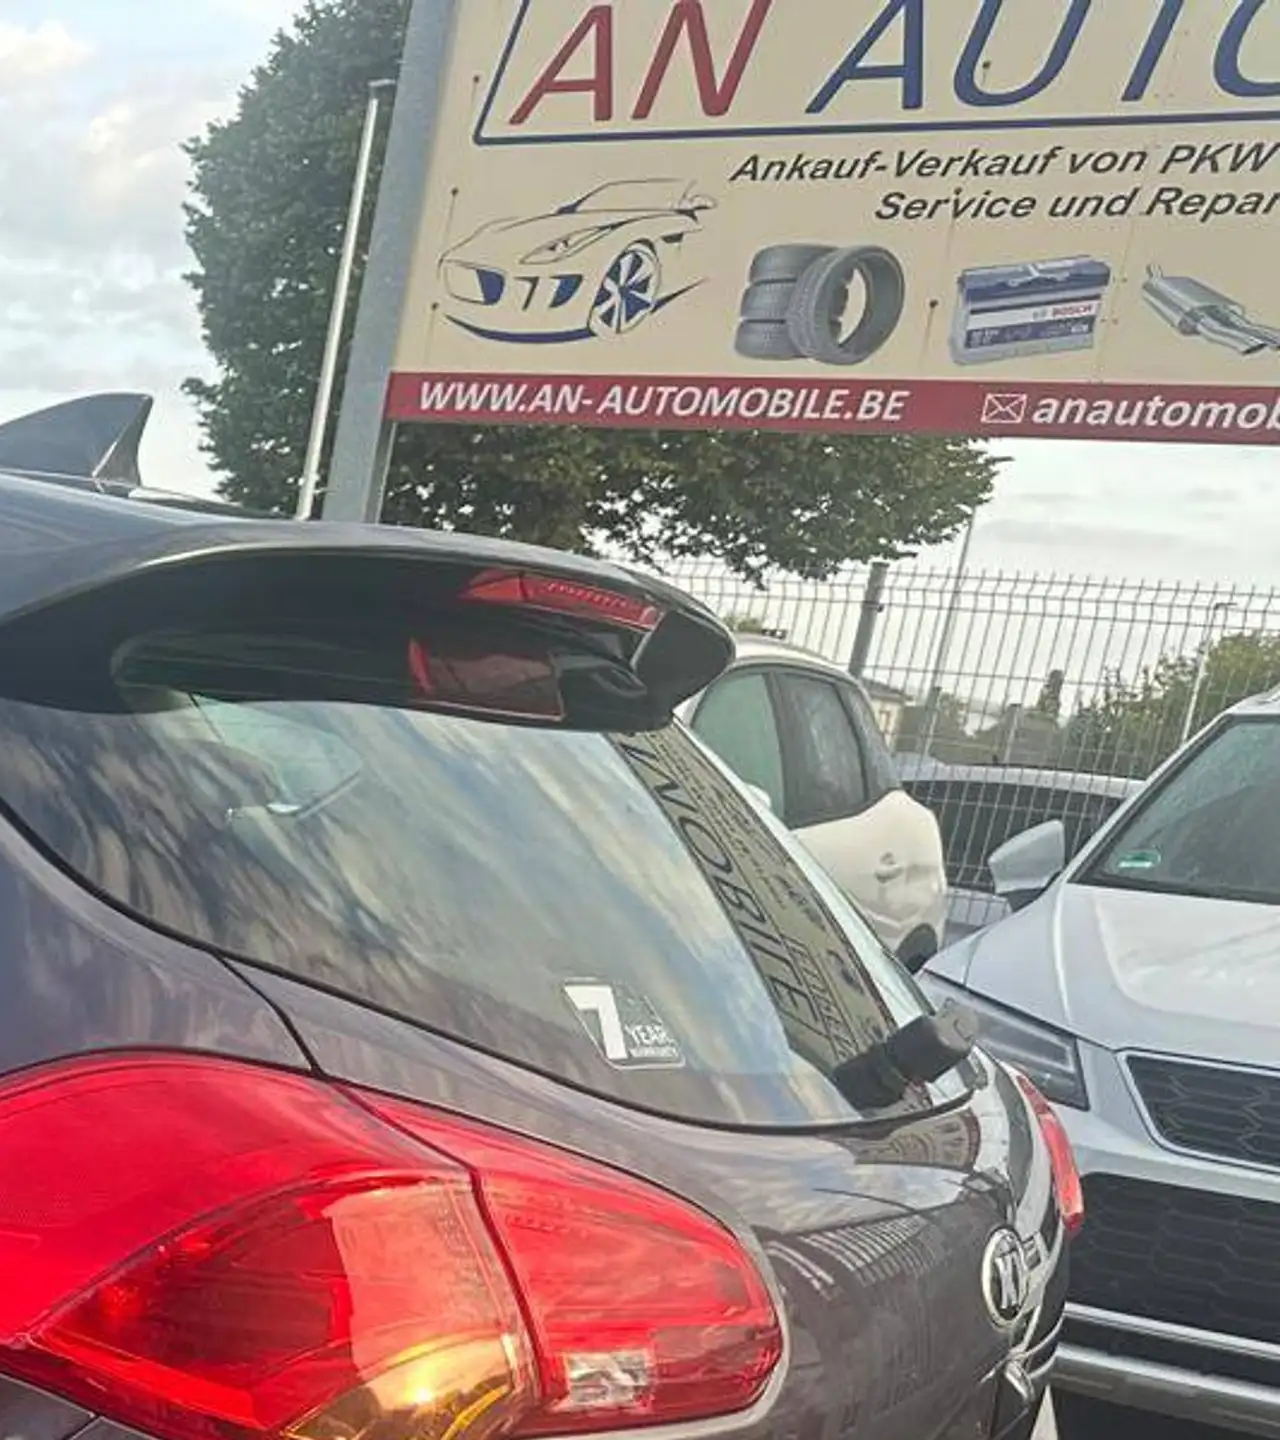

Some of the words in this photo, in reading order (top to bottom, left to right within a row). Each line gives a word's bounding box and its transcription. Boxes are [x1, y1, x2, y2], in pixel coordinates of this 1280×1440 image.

[508, 0, 773, 125] AN
[729, 146, 1064, 182] Ankauf-Verkauf
[1068, 150, 1148, 175] von
[1159, 142, 1280, 175] PKW
[874, 187, 1037, 220] Service
[1048, 186, 1140, 217] und
[563, 984, 629, 1060] 7
